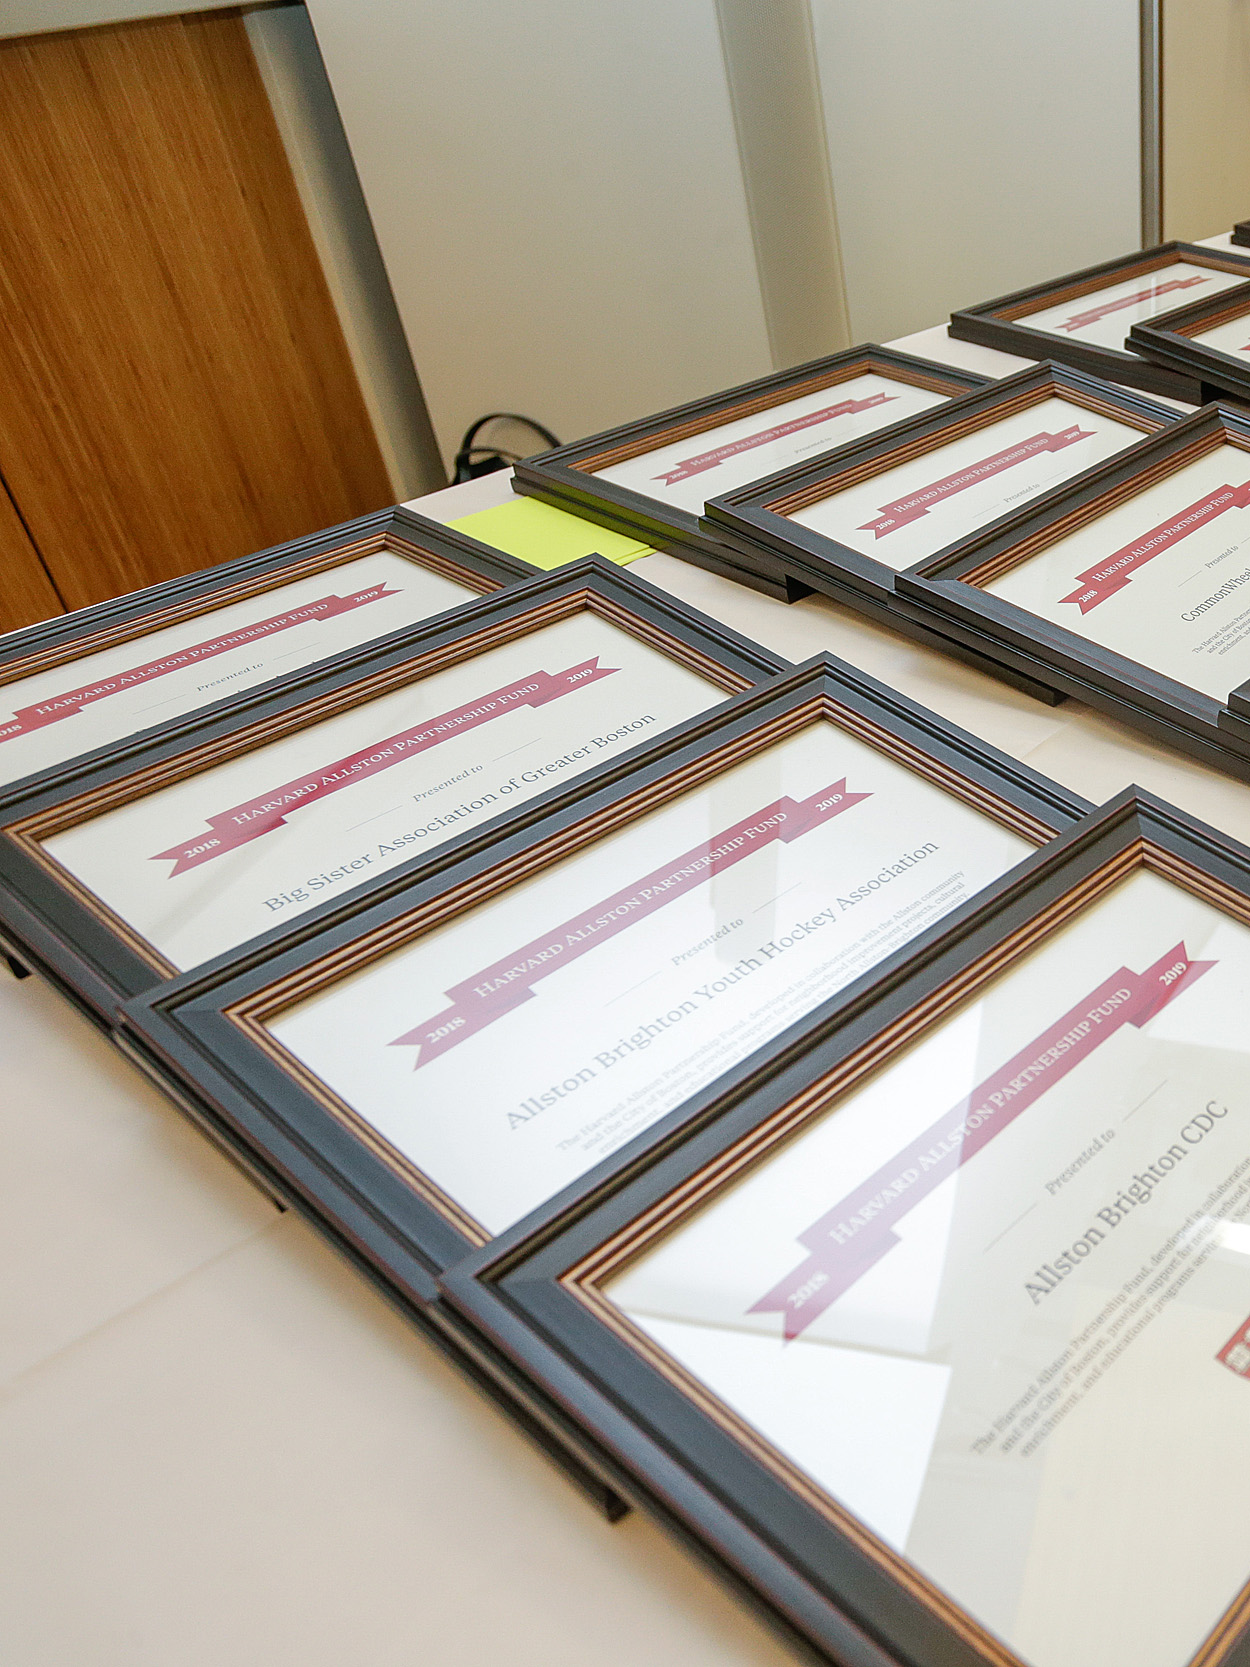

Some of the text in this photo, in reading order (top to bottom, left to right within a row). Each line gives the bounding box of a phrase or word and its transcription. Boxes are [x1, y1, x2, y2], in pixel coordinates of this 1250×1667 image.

[893, 439, 1048, 512] HARVARD ALLSTON PARTNERSHIP FUND
[1002, 486, 1035, 502] Presented
[874, 518, 896, 529] 2018
[1090, 493, 1234, 581] HARVARD ALLSTON PARTNERSHIP FUND
[1203, 548, 1233, 568] Presented
[352, 591, 379, 602] 2019
[1077, 589, 1098, 602] 2018
[36, 605, 327, 714] HARVARD ALLSTON PARTNERSHIP FUND
[195, 667, 251, 691] Presented
[566, 668, 593, 682] 2019
[232, 684, 538, 824] HARVARD ALLSTON PARTNERSHIP FUND
[410, 770, 471, 801] Presented
[264, 716, 656, 911] Big Sister Association of Greater Boston
[815, 793, 843, 811] 2019
[184, 838, 219, 858] 2018
[472, 813, 786, 997] HARVARD ALLSTON PARTNERSHIP FUND
[792, 980, 805, 988] in
[805, 942, 860, 980] collaboration
[860, 929, 879, 941] with
[877, 920, 892, 929] the
[892, 899, 923, 920] Allston
[922, 871, 964, 900] community
[669, 919, 744, 965] Presented to
[788, 962, 849, 1006] neighborhood
[846, 925, 903, 964] improvement
[901, 905, 936, 927] projects,
[935, 881, 965, 903] cultural
[1158, 961, 1188, 985] 2019
[507, 1069, 597, 1130] Allston
[594, 1003, 698, 1068] Brighton
[694, 960, 763, 999] Youth
[760, 909, 837, 959] Hockey
[836, 843, 939, 910] Association
[424, 1016, 466, 1043] 2018
[918, 1105, 995, 1171] ALLSTON
[989, 1022, 1091, 1107] PARTNERSHIP
[1087, 989, 1132, 1024] FUND
[1042, 1129, 1117, 1195] Presented to
[1024, 1228, 1107, 1305] Allston
[1096, 1146, 1188, 1228] Brighton
[1180, 1101, 1228, 1143] CDC
[1036, 1351, 1073, 1387] Allston
[1069, 1294, 1127, 1350] Partnership
[1150, 1218, 1196, 1265] developed
[1060, 1372, 1073, 1387] of
[1146, 1256, 1181, 1294] support
[1176, 1244, 1193, 1259] for
[1083, 1367, 1103, 1390] and
[1102, 1309, 1155, 1369] educational
[1153, 1268, 1195, 1313] programs
